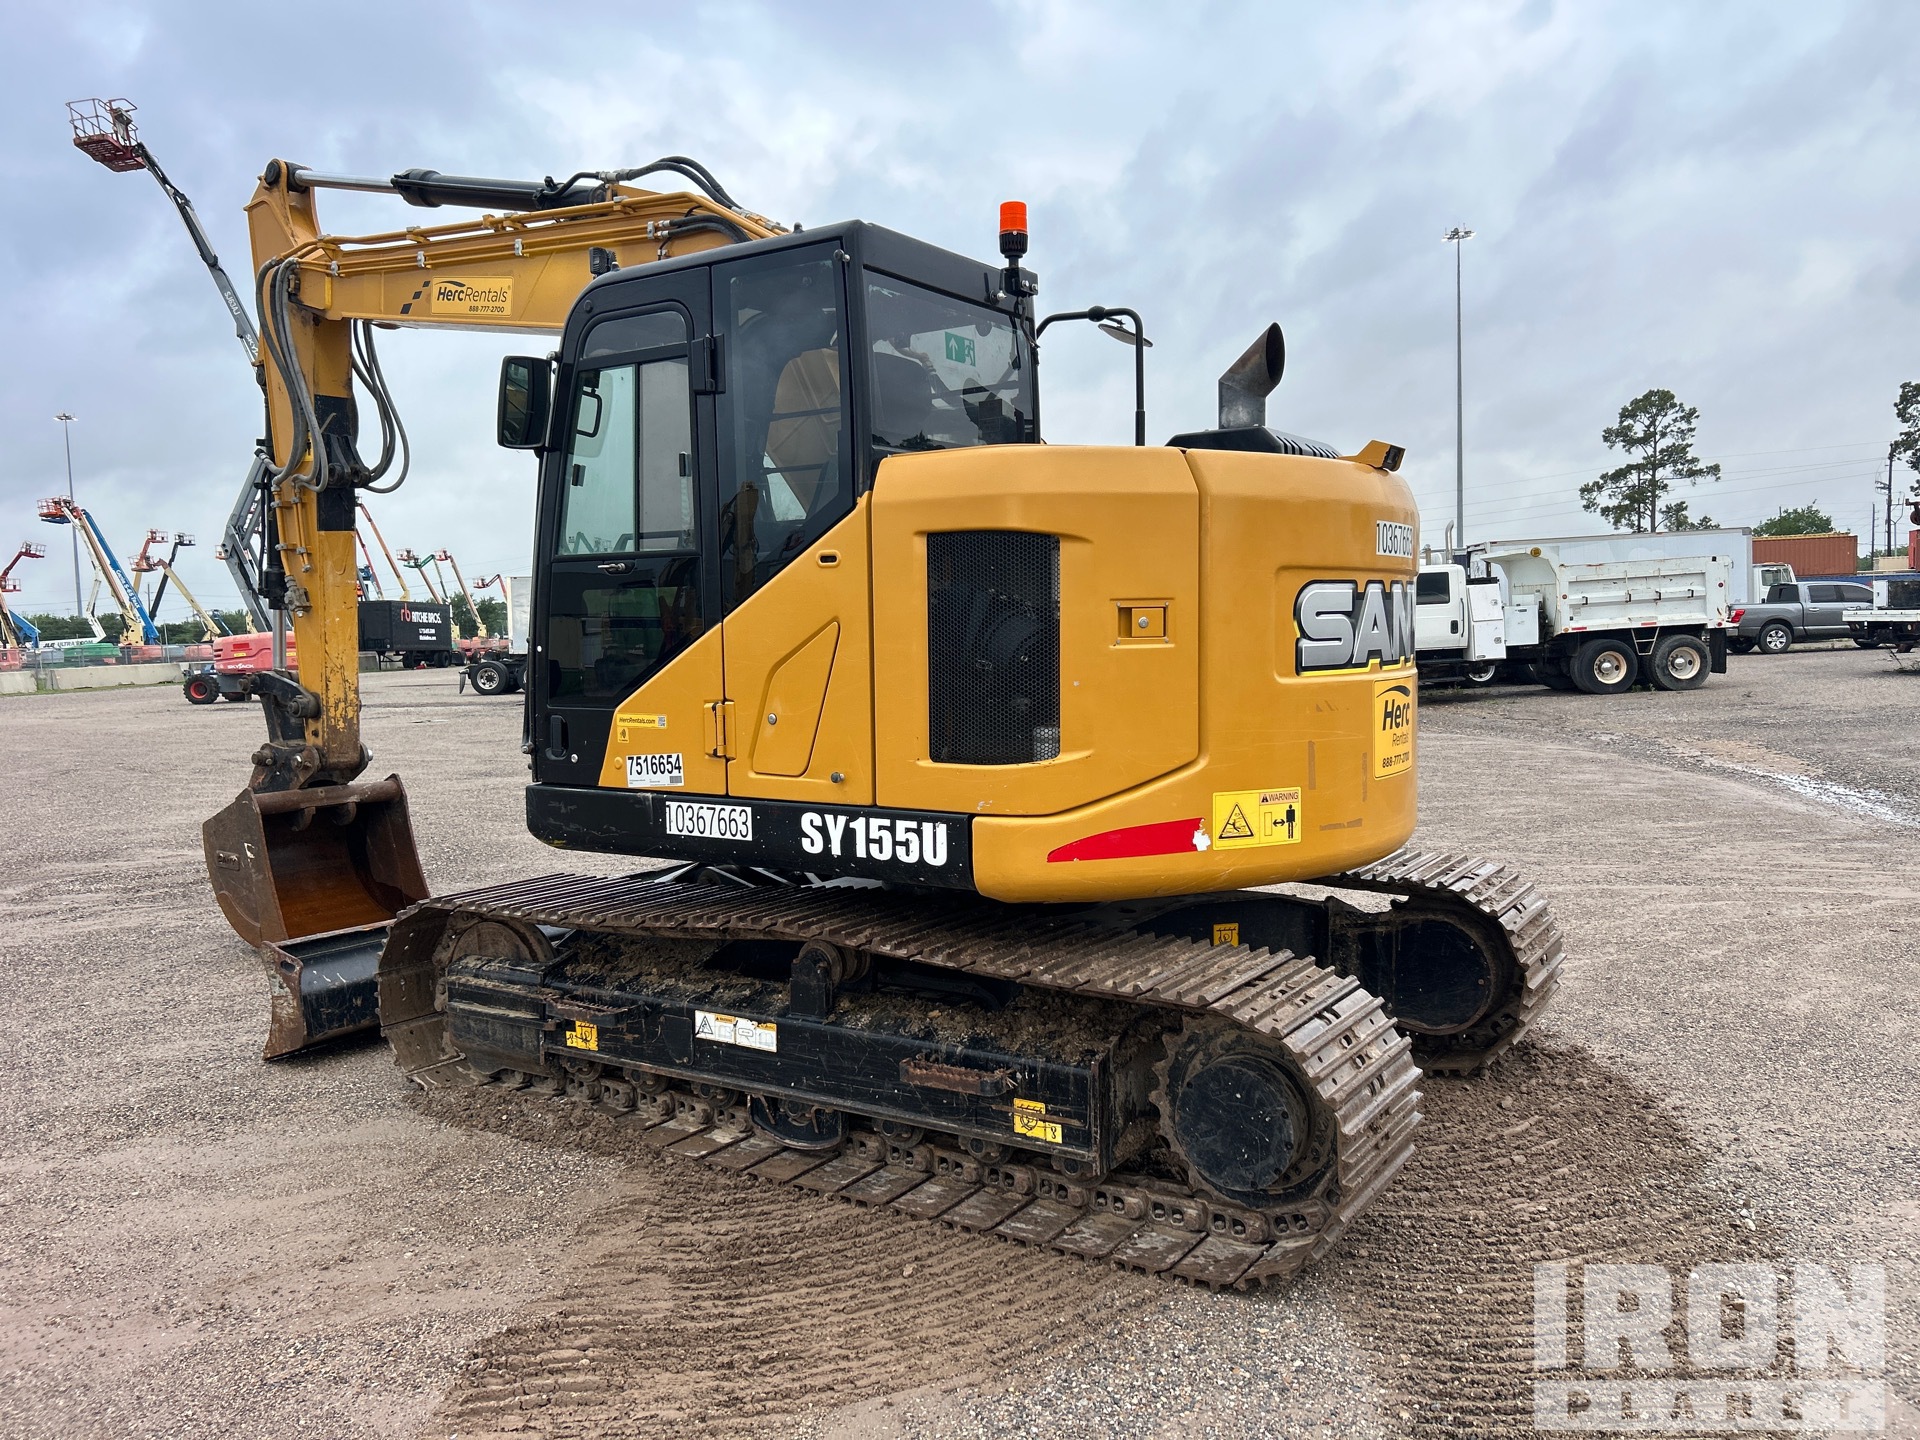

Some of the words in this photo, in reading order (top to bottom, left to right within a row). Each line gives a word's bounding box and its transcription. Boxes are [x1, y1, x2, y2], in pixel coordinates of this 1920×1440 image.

[224, 291, 241, 315] SJ63AJ
[436, 286, 508, 303] HercRentals
[468, 305, 505, 313] 888-777-2700
[1376, 522, 1413, 557] 10367663
[618, 716, 656, 725] HercRentals.com
[1382, 698, 1410, 731] Herc
[627, 753, 682, 776] 7516654
[1268, 791, 1299, 802] WARNING
[666, 804, 749, 839] 10367663
[800, 811, 948, 867] SY155U
